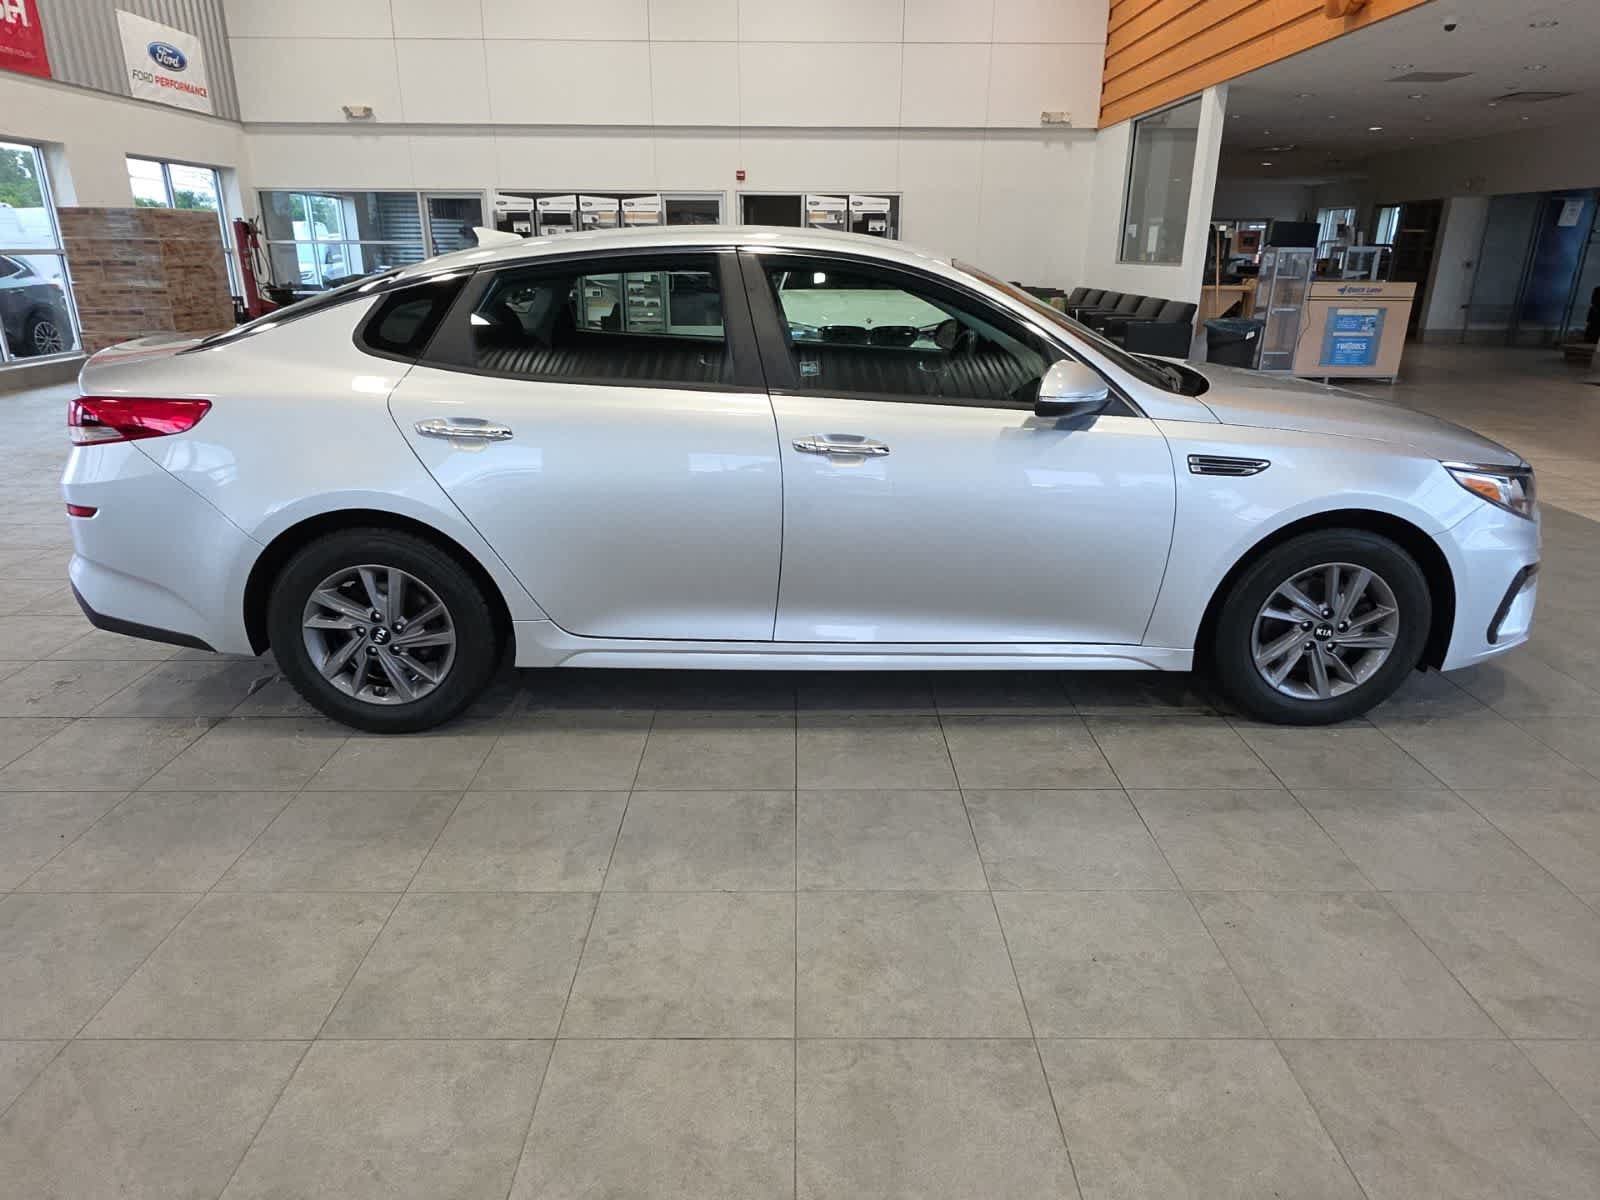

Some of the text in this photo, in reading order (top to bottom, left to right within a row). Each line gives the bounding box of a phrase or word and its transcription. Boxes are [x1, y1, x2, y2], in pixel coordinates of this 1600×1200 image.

[156, 45, 180, 68] Ford
[132, 69, 208, 98] FORD PERFORMANCE
[1316, 628, 1332, 637] KIA
